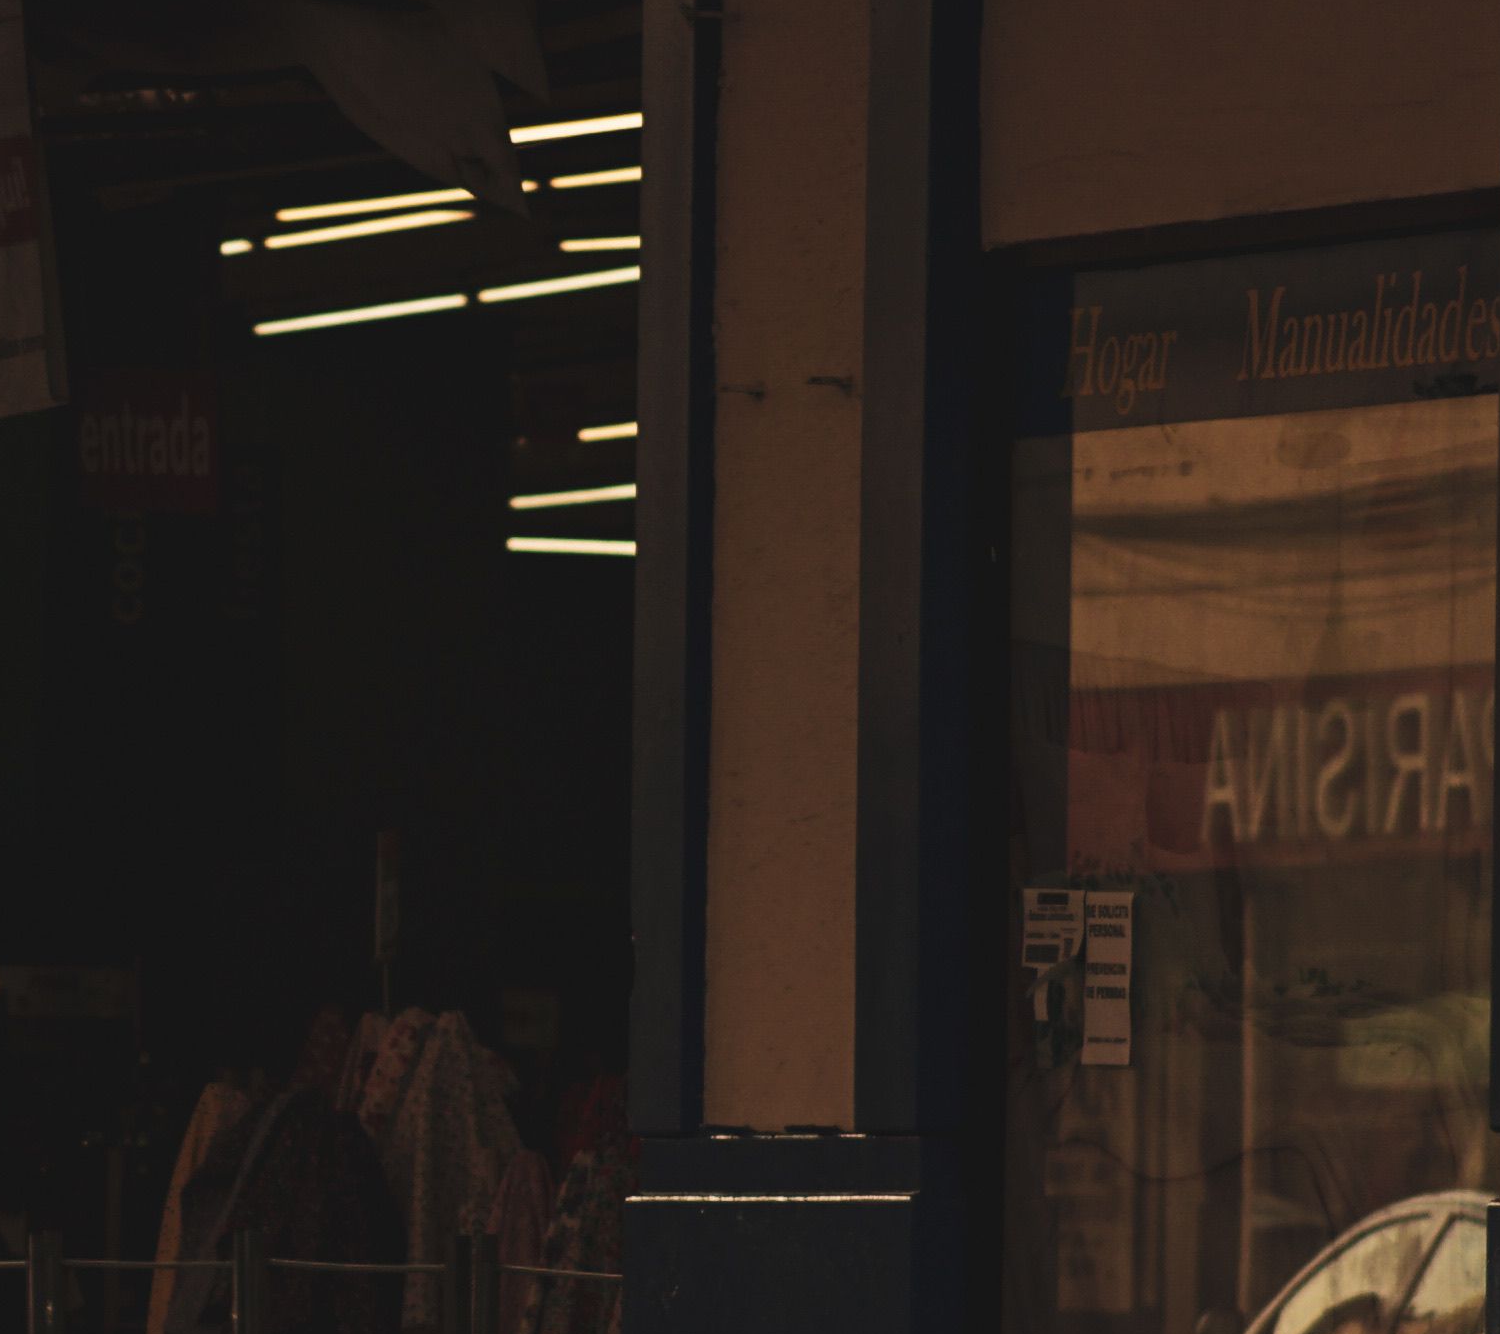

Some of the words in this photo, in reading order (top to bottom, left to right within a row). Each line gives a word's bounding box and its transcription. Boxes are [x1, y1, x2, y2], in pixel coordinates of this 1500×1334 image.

[1062, 305, 1177, 415] Hogar
[1236, 265, 1500, 383] Manualidades
[80, 391, 210, 477] entrada
